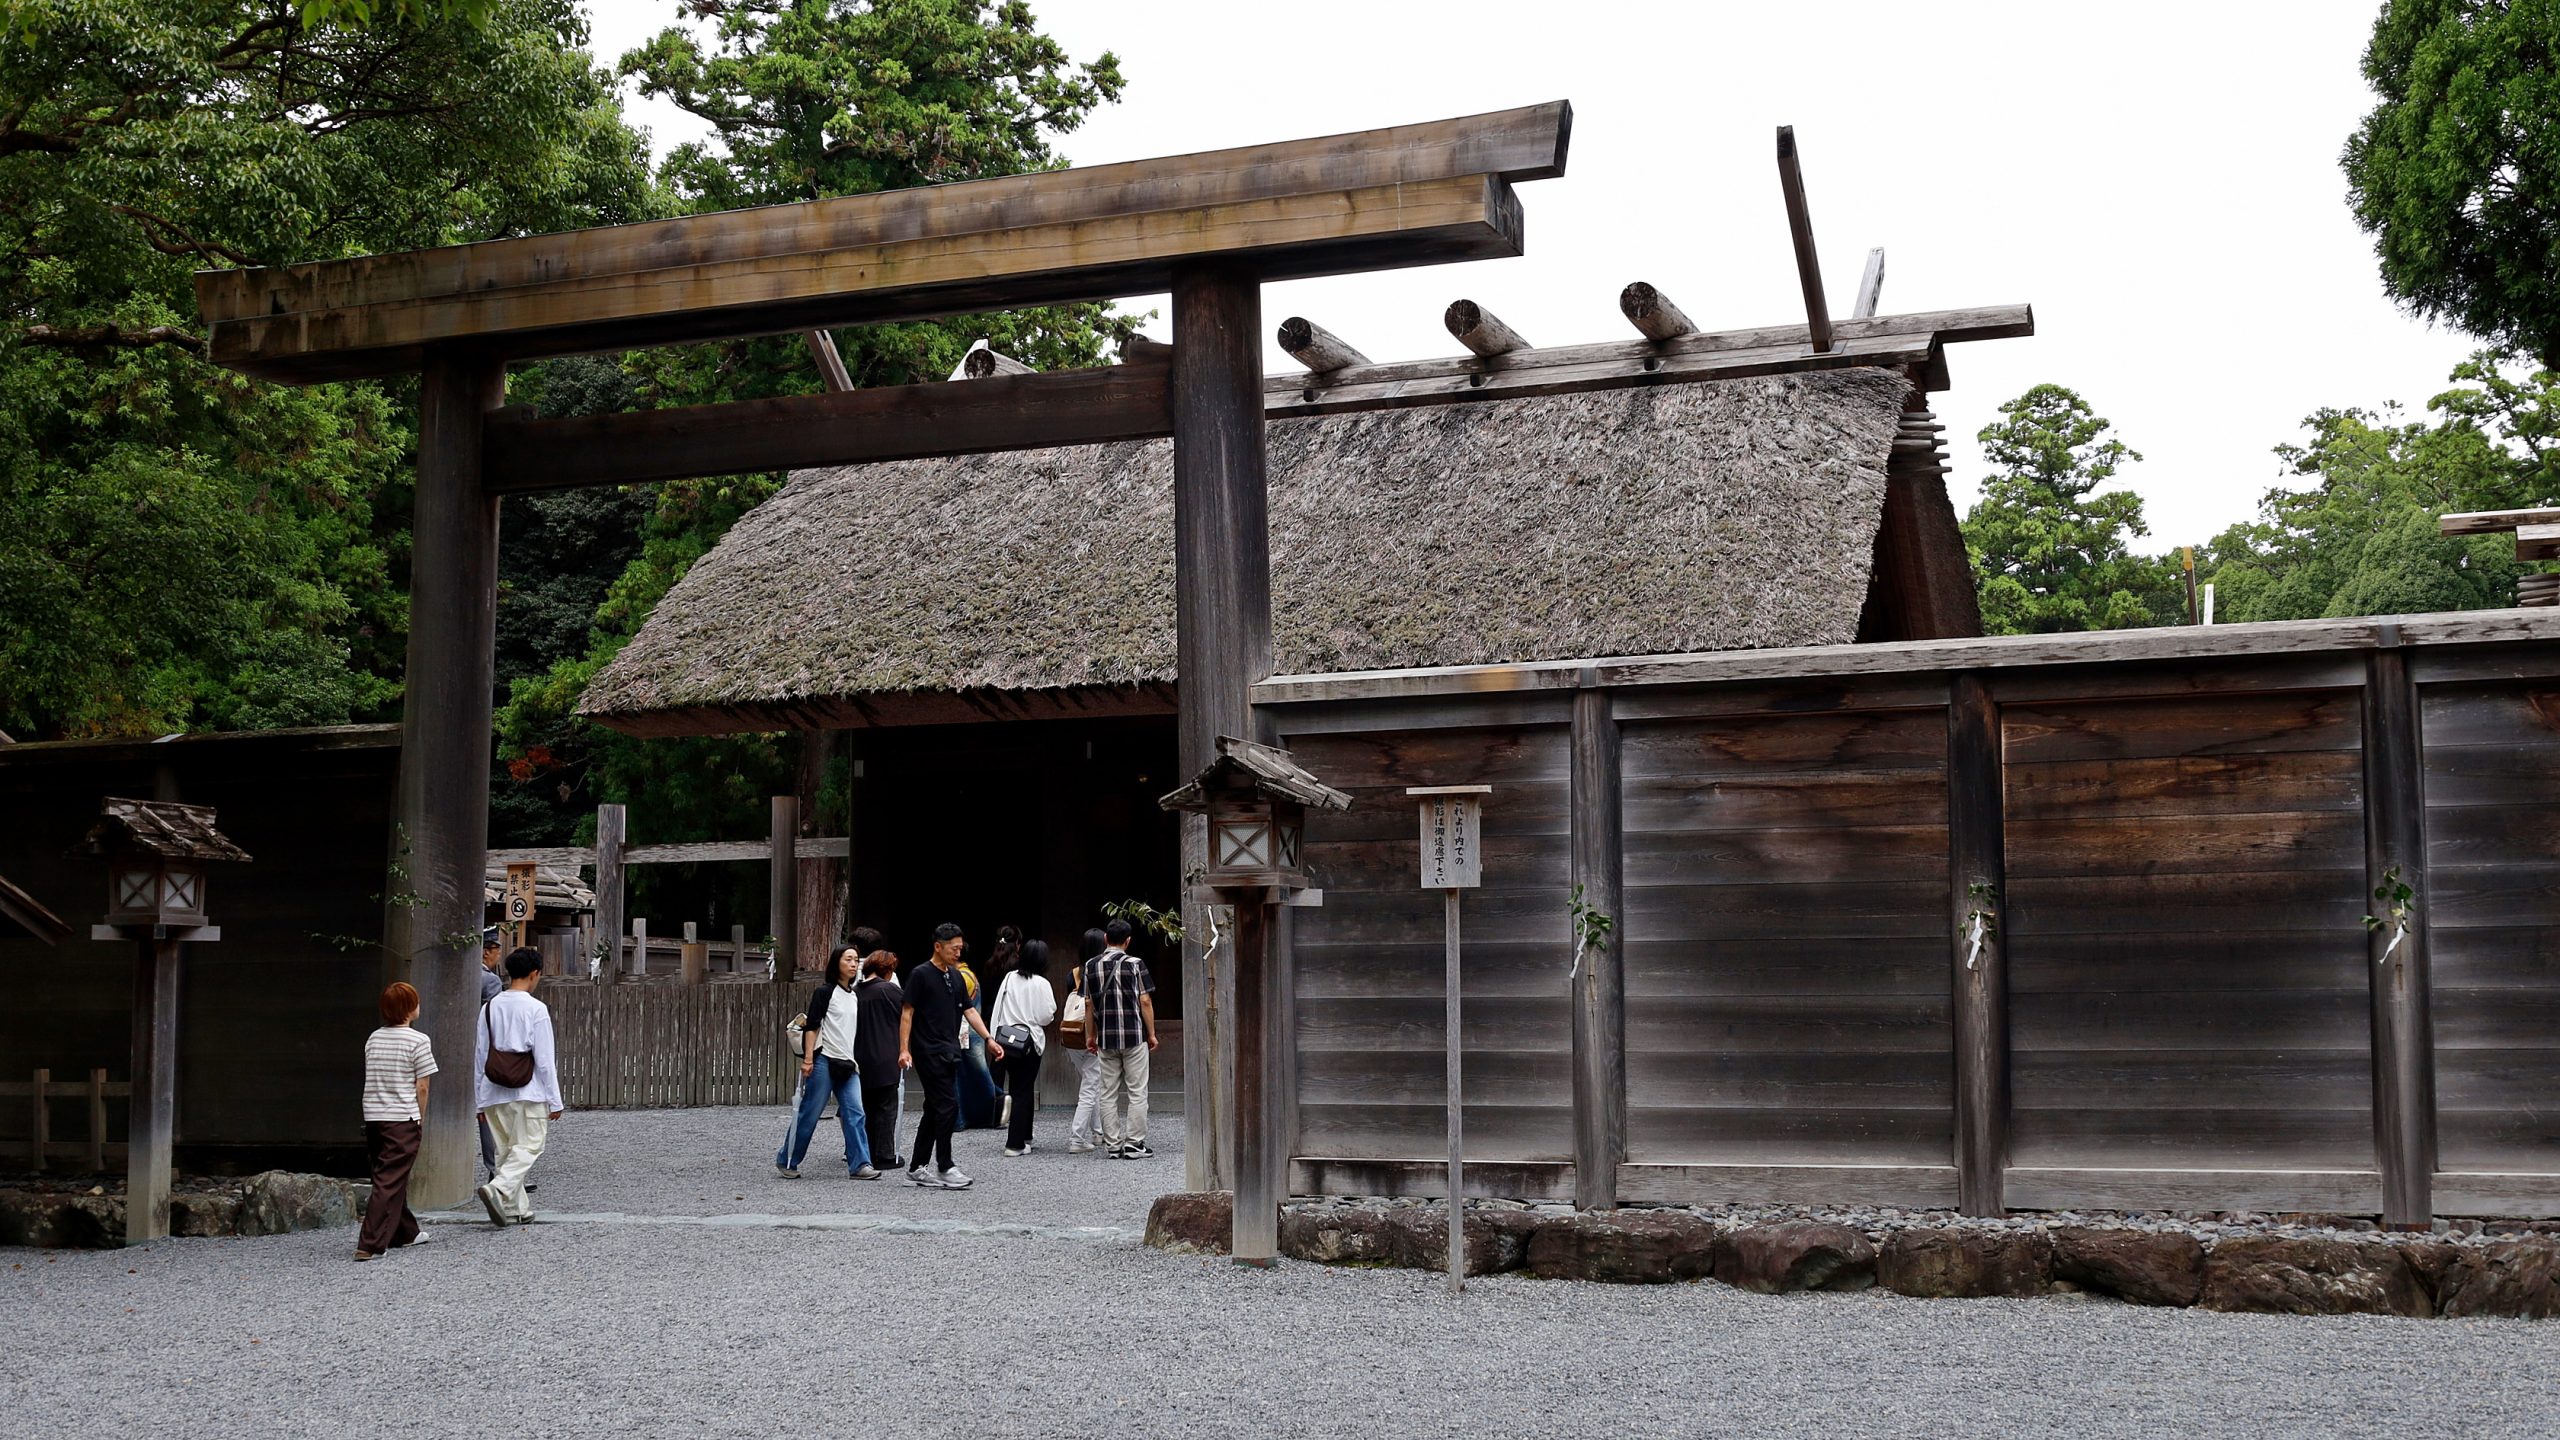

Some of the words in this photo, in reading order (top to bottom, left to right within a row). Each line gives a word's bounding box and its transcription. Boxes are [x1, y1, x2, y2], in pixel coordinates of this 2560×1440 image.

[1454, 797, 1464, 865] これより内での
[509, 873, 518, 896] 禁止
[521, 868, 531, 891] 撮影
